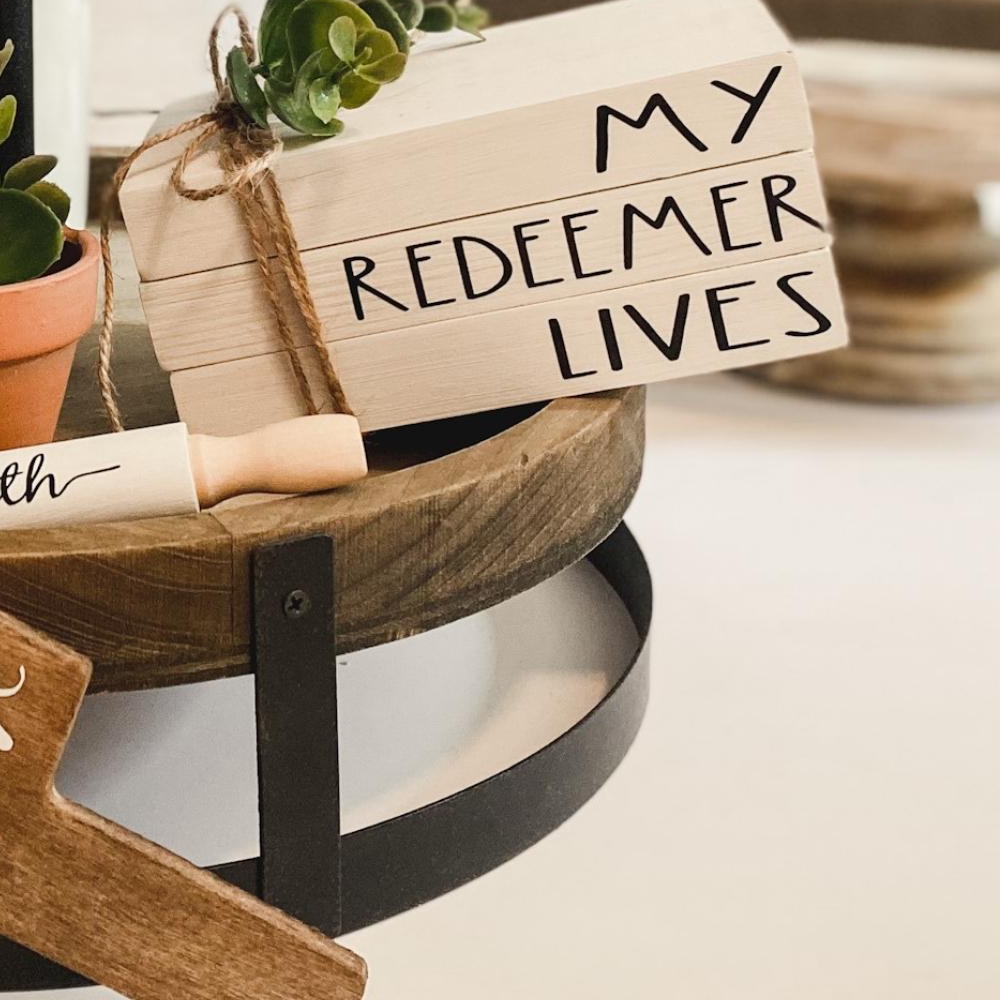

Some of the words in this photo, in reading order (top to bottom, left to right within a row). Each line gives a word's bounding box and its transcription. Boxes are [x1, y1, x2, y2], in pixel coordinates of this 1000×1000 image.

[596, 65, 783, 173] MY
[342, 174, 825, 320] REDEEMER
[548, 271, 832, 380] LIVES
